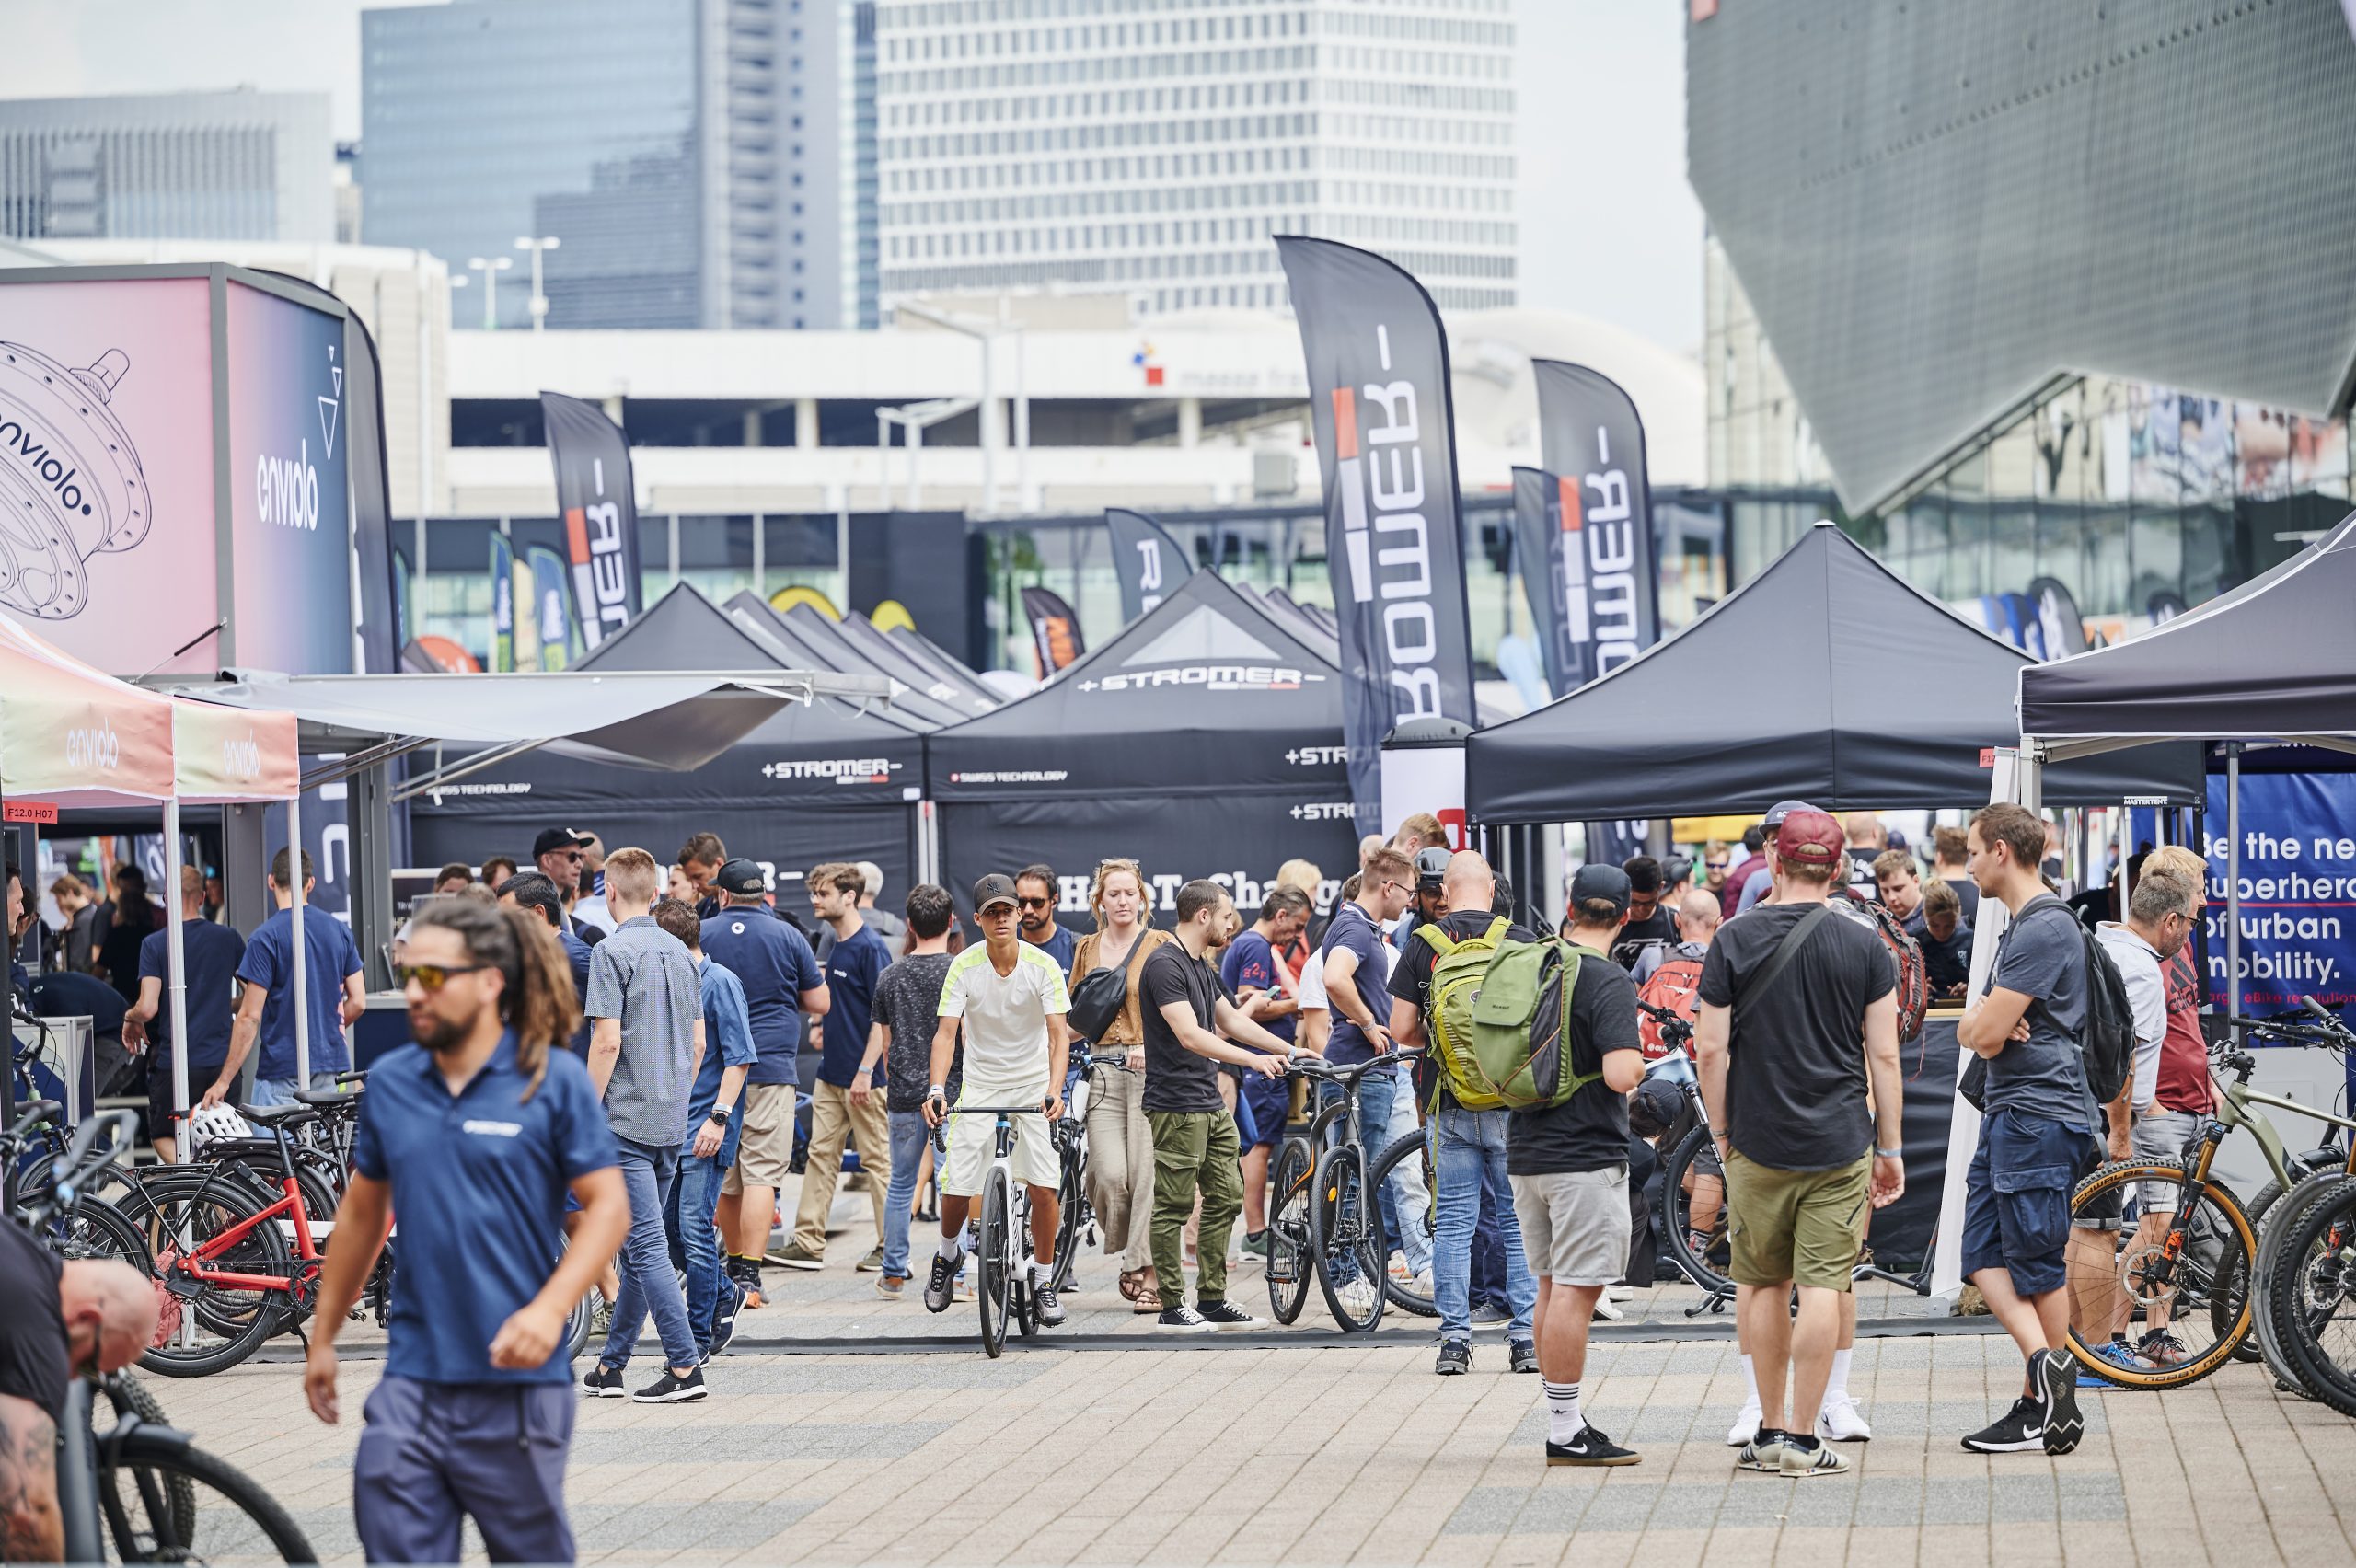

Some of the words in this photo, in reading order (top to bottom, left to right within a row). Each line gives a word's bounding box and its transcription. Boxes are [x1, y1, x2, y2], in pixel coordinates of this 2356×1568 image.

[257, 437, 318, 532] enviolo
[66, 716, 119, 769] enviolo
[224, 728, 260, 778] enviolo
[996, 770, 1068, 782] TECHNOLOGY
[7, 808, 33, 818] F12.0
[35, 810, 53, 819] H07
[2245, 832, 2301, 860] the
[2239, 912, 2341, 940] urban
[2244, 990, 2282, 1004] eBike
